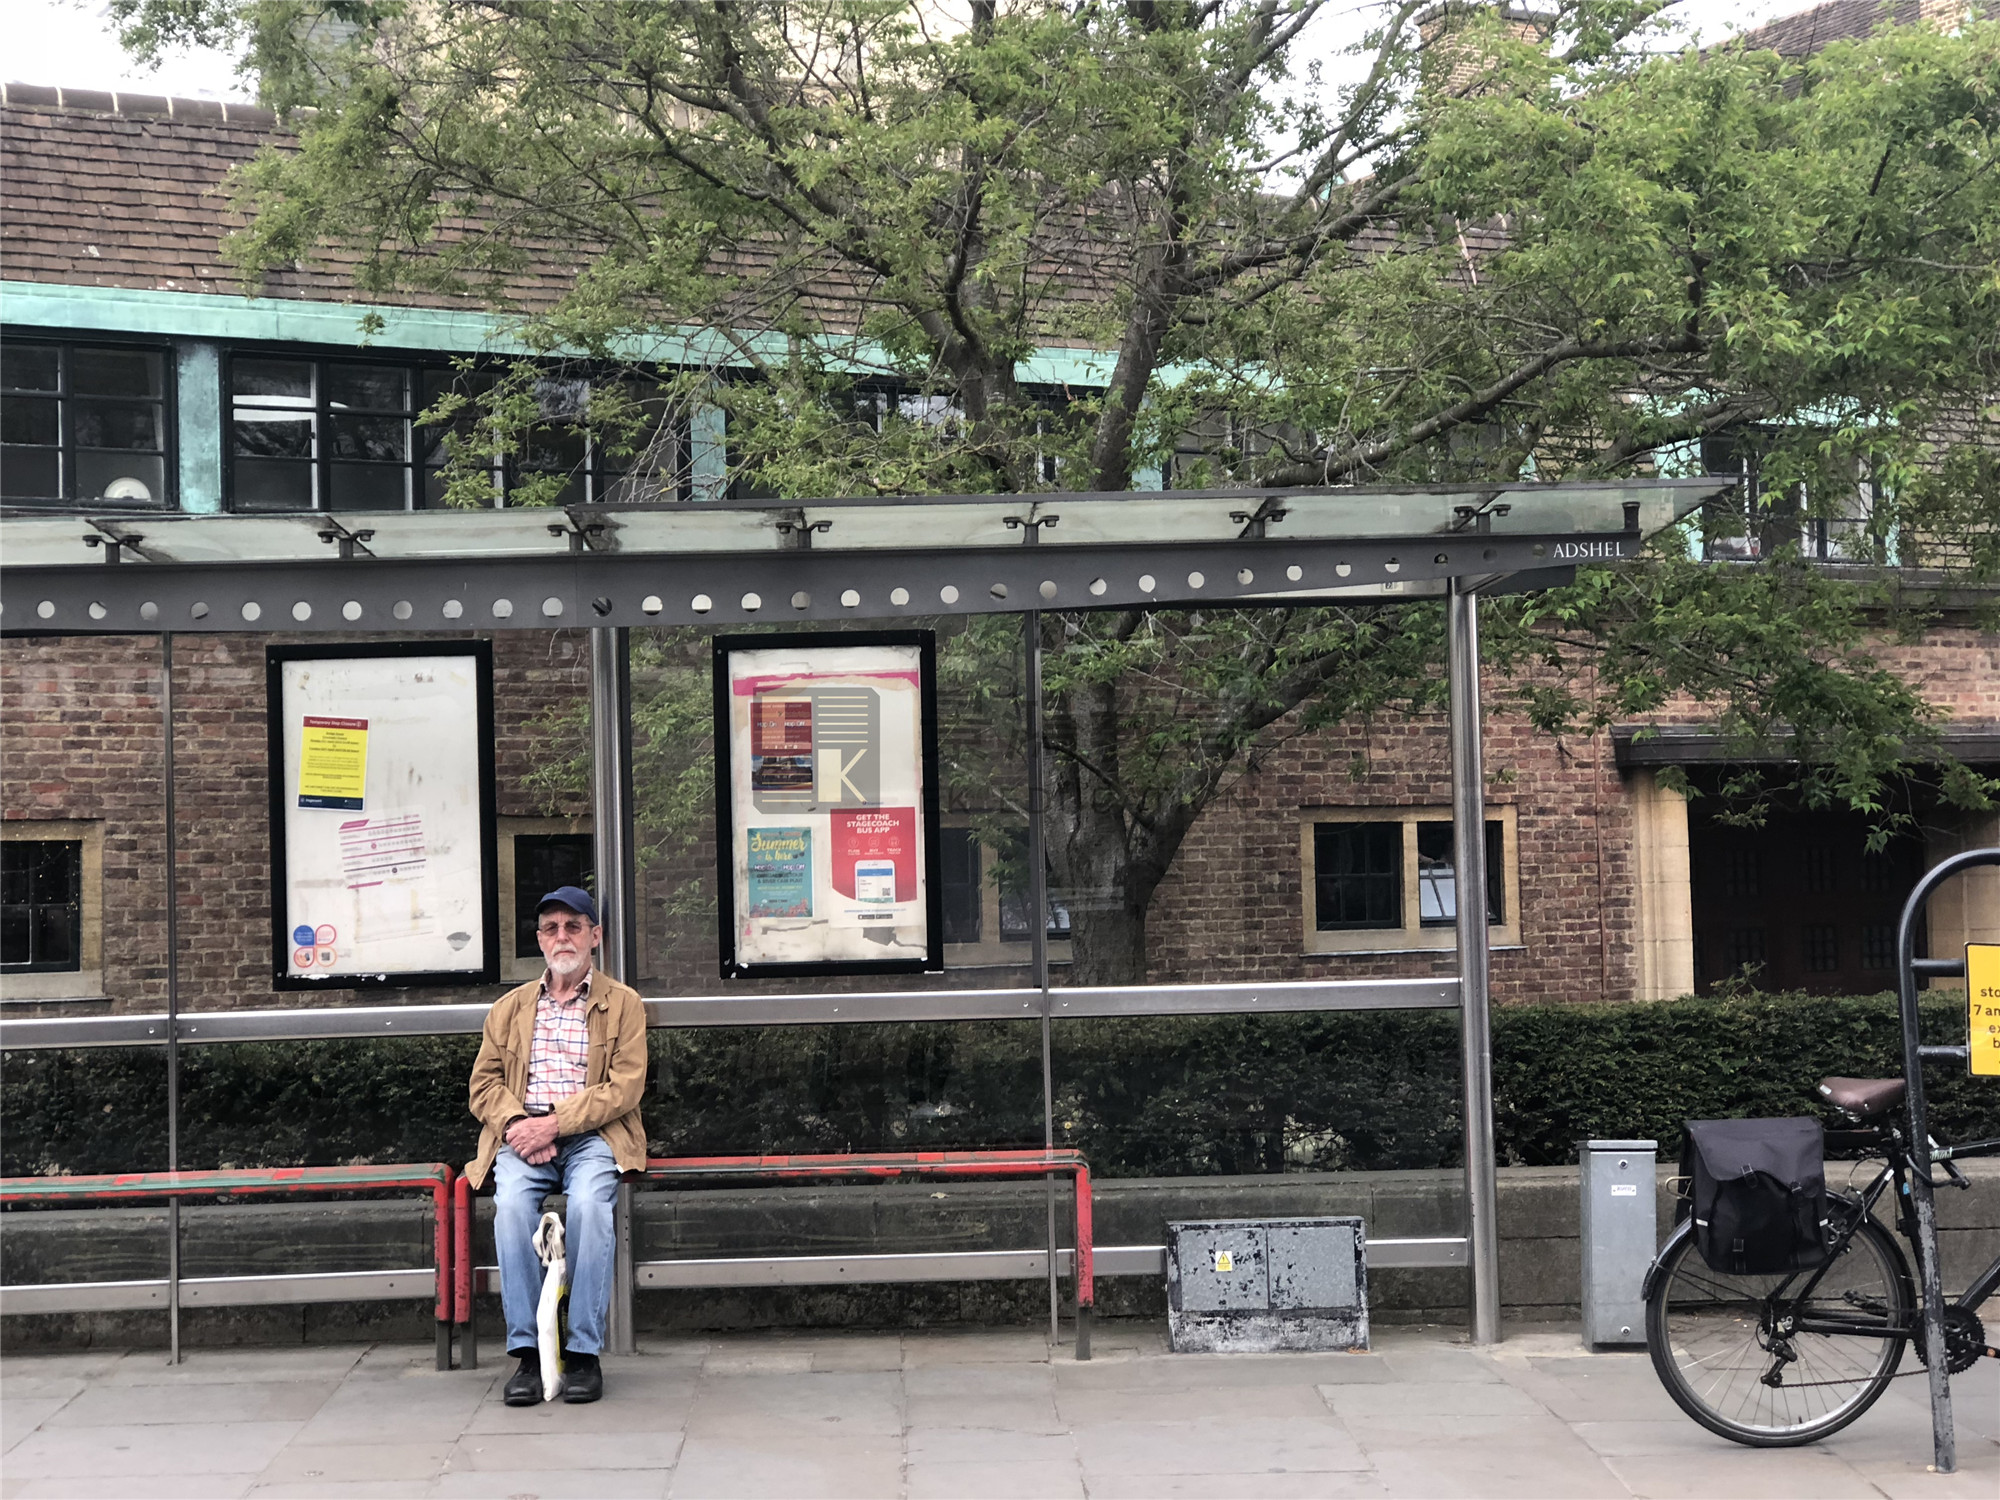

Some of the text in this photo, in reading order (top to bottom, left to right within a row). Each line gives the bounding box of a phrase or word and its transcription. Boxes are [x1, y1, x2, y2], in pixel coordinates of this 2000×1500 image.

[1553, 541, 1625, 558] ADSHEL
[846, 820, 899, 828] STAGECOACH
[751, 831, 807, 852] Summer
[1973, 1004, 1982, 1016] 7
